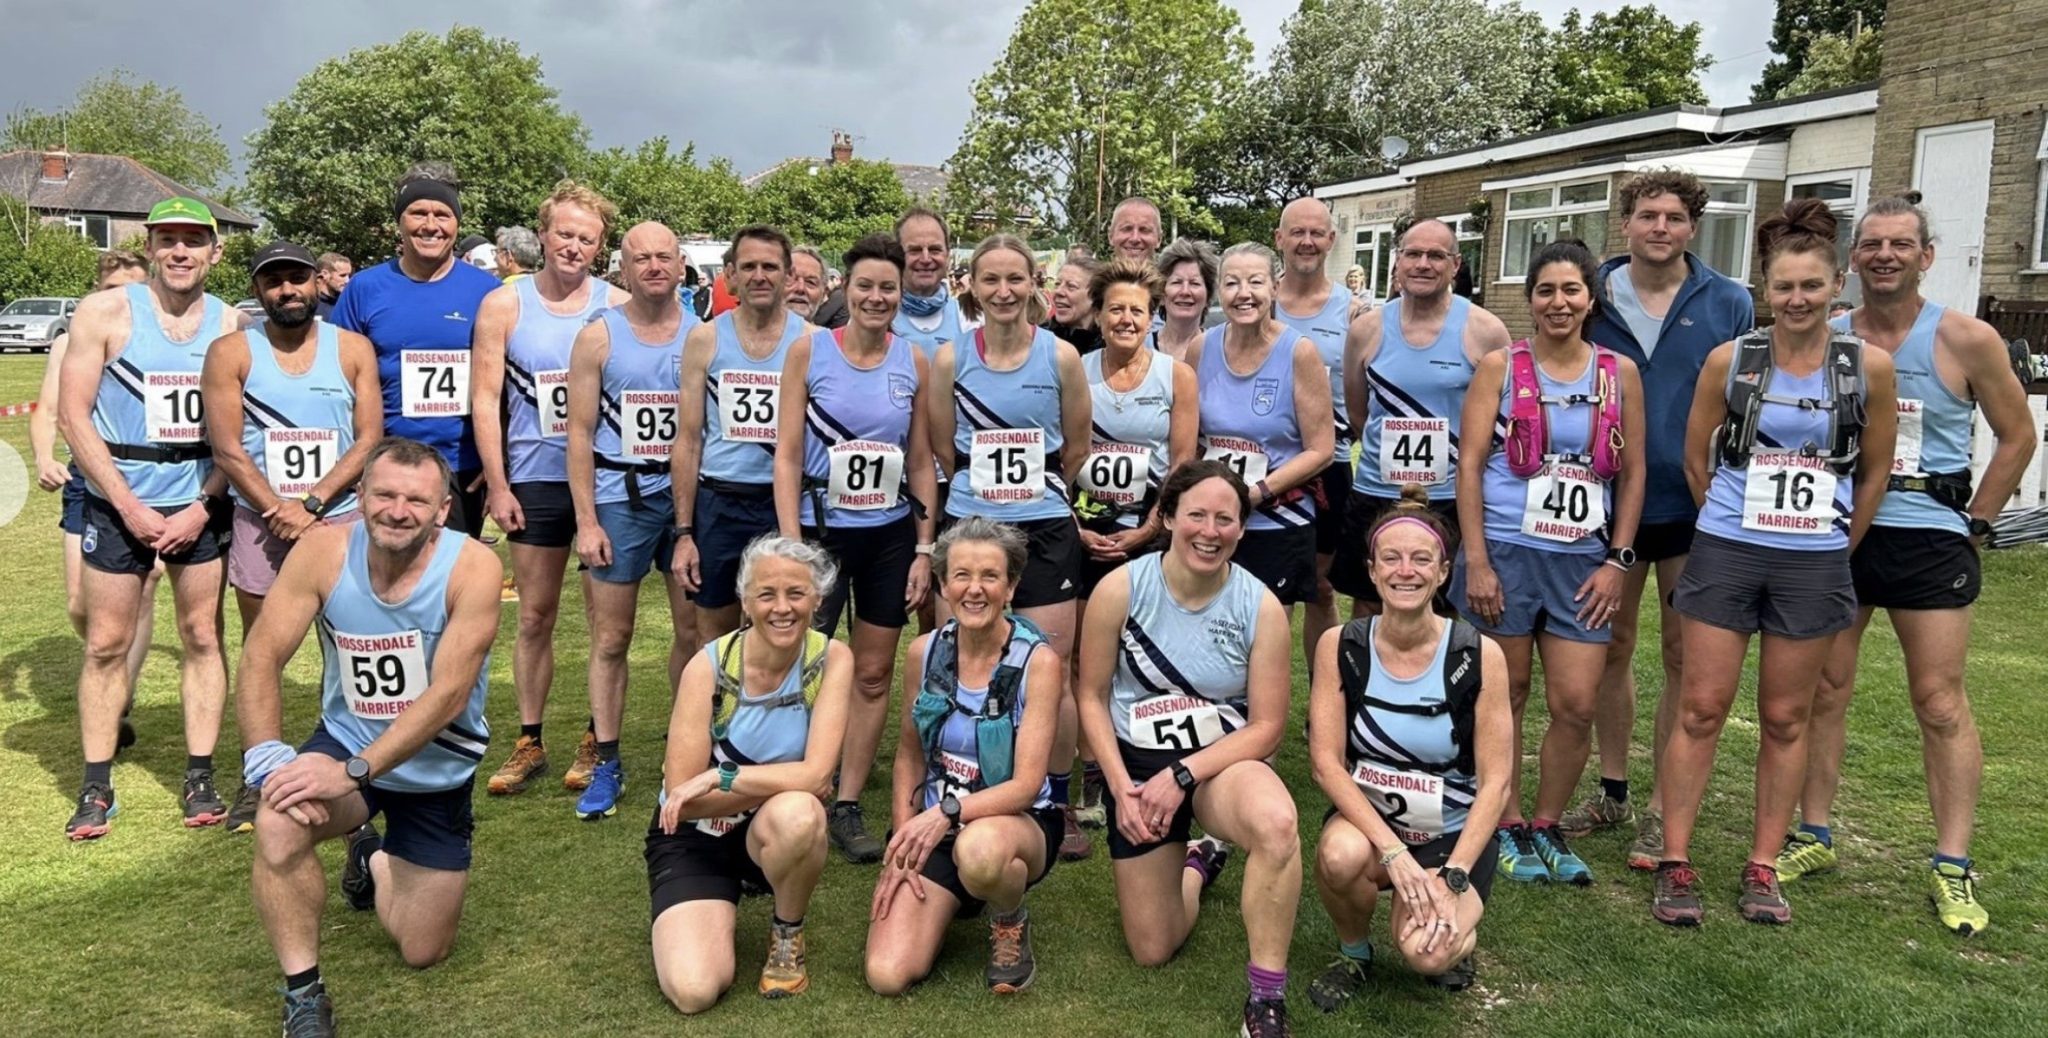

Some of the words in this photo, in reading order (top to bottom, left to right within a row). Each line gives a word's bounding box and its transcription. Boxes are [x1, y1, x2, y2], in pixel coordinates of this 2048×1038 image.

[405, 353, 467, 363] ROSSENDALE
[418, 367, 456, 399] 74
[539, 373, 569, 384] ROSSE
[723, 373, 780, 386] ROSSENDAL
[163, 389, 204, 423] 10
[413, 402, 461, 413] HARRIERS
[551, 386, 568, 419] 9
[625, 393, 680, 404] ROSSENDAL
[732, 387, 774, 424] 33
[636, 407, 677, 441] 93
[729, 426, 777, 439] HARRIERS
[1385, 420, 1444, 431] ROSSENDALE
[270, 430, 334, 442] ROSSENDALE
[976, 432, 1040, 444] ROSSENDALE
[633, 444, 673, 455] HARRIER
[1092, 443, 1145, 454] OSSENDALE
[1392, 434, 1434, 468] 44
[284, 444, 321, 480] 91
[987, 447, 1028, 484] 15
[1090, 455, 1133, 489] 60
[847, 454, 885, 491] 81
[1390, 470, 1436, 481] HARRIERS
[839, 493, 886, 506] HARRIERS
[982, 488, 1033, 500] HARRIERS
[1769, 470, 1815, 512] 16
[1543, 481, 1589, 523] 40
[1534, 521, 1590, 539] HARRIERS
[1757, 513, 1818, 529] HARRIERS
[337, 635, 416, 652] ROSSENDALE
[351, 654, 406, 698] 59
[1135, 697, 1209, 720] ROSSENDALE
[1153, 715, 1201, 750] 51
[1359, 766, 1437, 794] ROSSENDALE
[1384, 792, 1410, 828] 2
